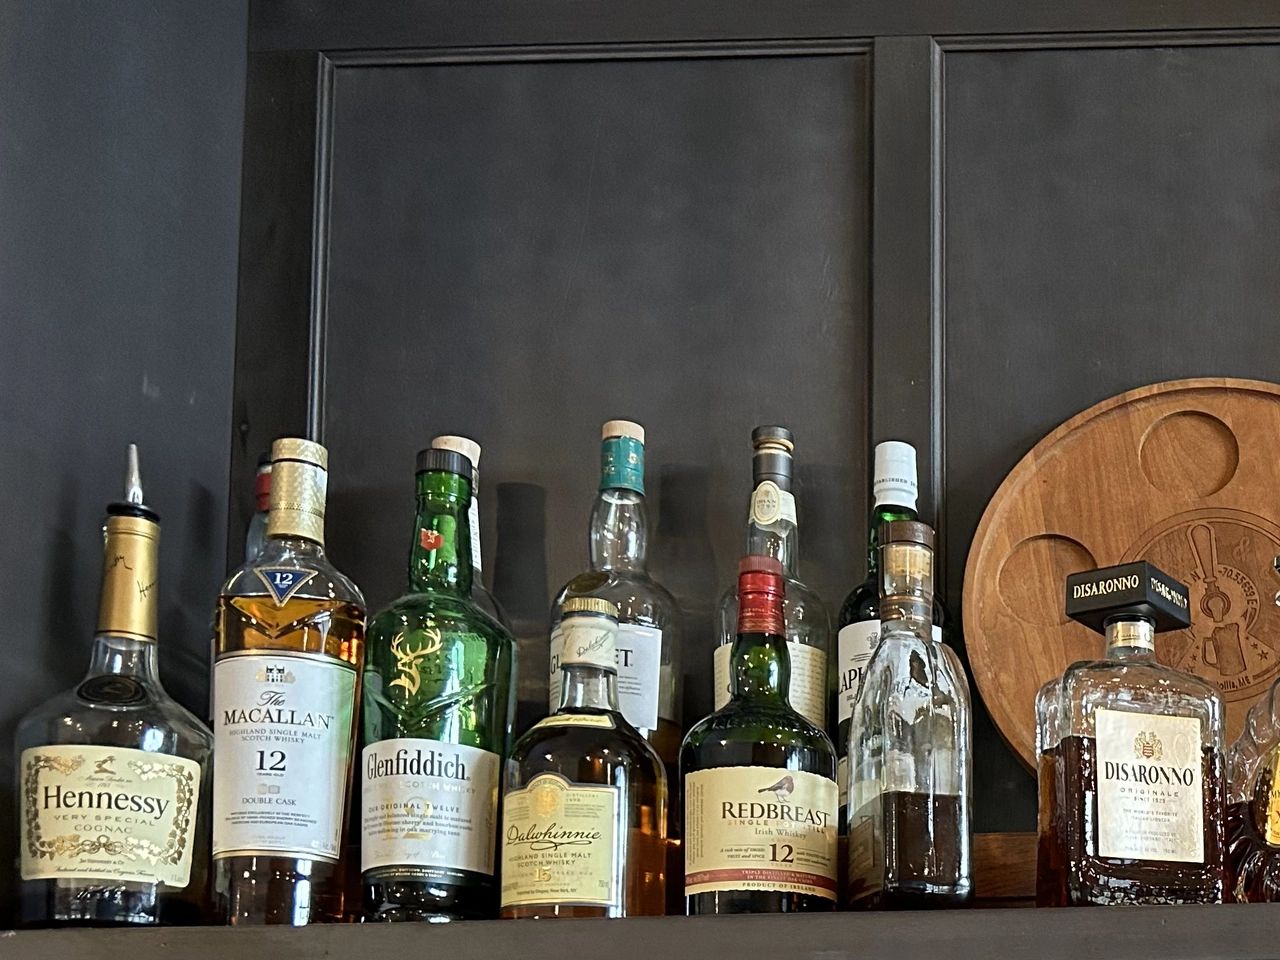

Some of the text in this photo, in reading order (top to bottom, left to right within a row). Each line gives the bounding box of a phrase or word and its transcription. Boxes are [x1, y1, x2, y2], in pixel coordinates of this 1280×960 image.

[274, 573, 294, 585] 12
[1073, 574, 1139, 599] DISARONNO
[1238, 675, 1251, 688] ME
[257, 690, 286, 706] The
[223, 708, 330, 730] MACALLAN
[269, 728, 299, 737] SINGLE
[301, 731, 322, 740] MALT
[274, 735, 305, 744] WHISKY
[255, 750, 287, 772] 12
[367, 749, 467, 780] Glenfiddich
[1105, 761, 1194, 787] DISARONNO
[1120, 787, 1179, 798] ORIGINALE
[43, 785, 170, 820] Hennessy
[242, 797, 297, 806] DOUBLE CASK
[380, 803, 421, 811] ORIGINAL
[426, 804, 460, 813] TWELVE
[95, 814, 156, 827] SPECIAL
[722, 802, 830, 828] REDBREAST
[74, 824, 132, 834] COGNAC
[506, 823, 601, 846] Dalwhinnie
[754, 827, 807, 841] Irish Whiskey
[768, 844, 794, 864] 12
[534, 865, 552, 883] 15
